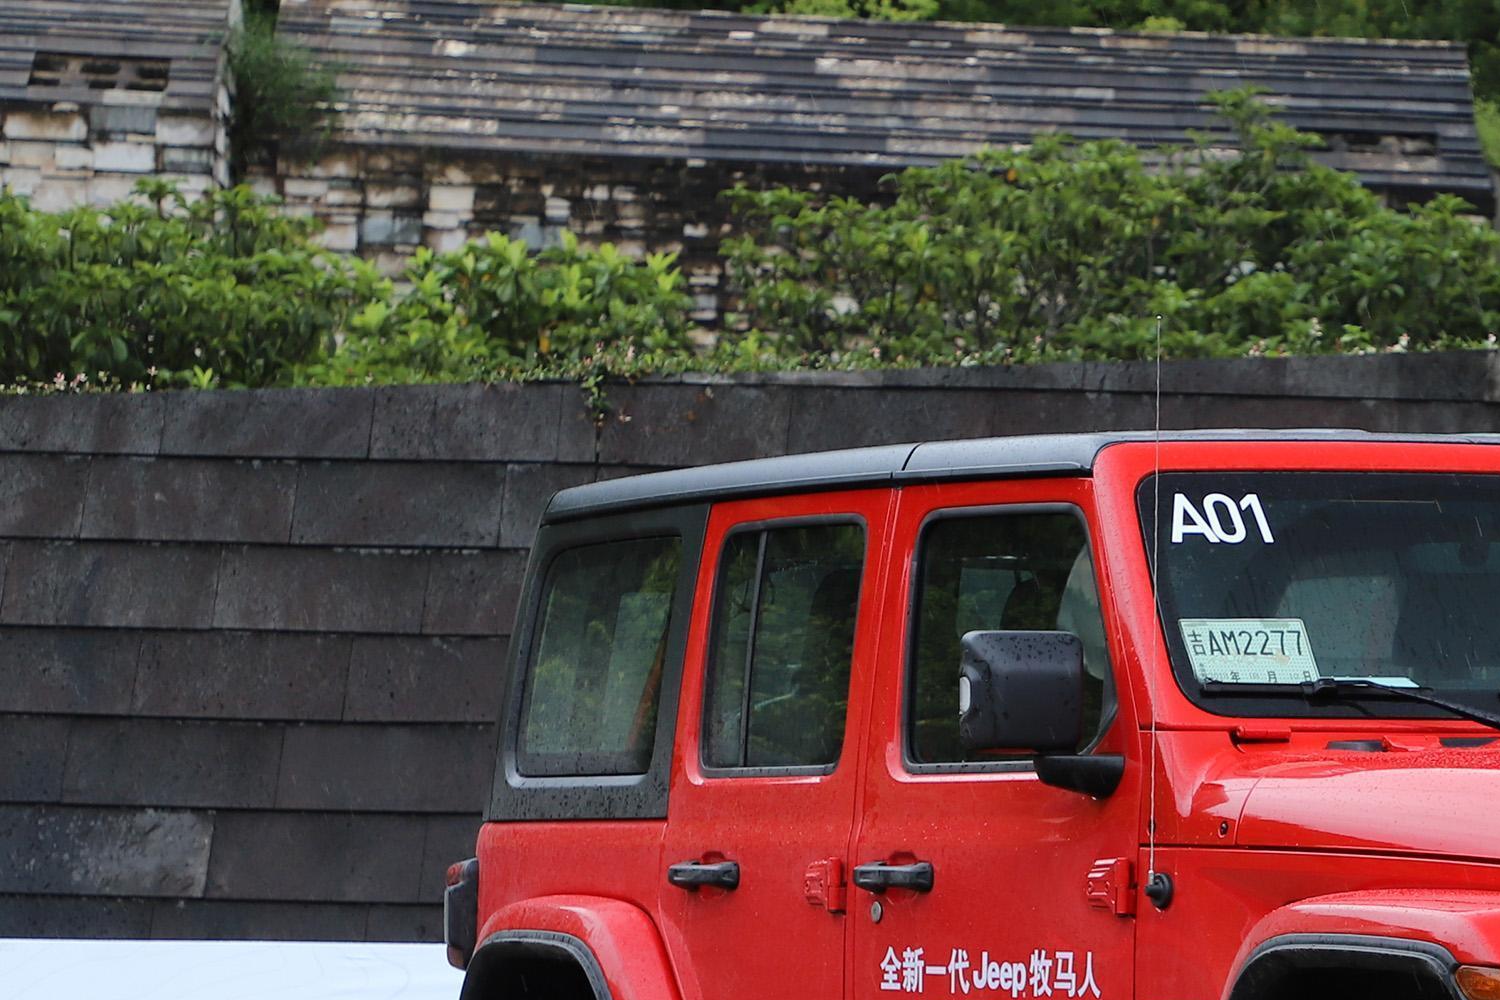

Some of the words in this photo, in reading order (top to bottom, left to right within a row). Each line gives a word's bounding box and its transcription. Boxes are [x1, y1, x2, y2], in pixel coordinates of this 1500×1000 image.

[1172, 493, 1274, 543] A01
[1188, 630, 1303, 656] 吉AM2277
[880, 946, 1101, 998] 全新一代Jeep牧马人
